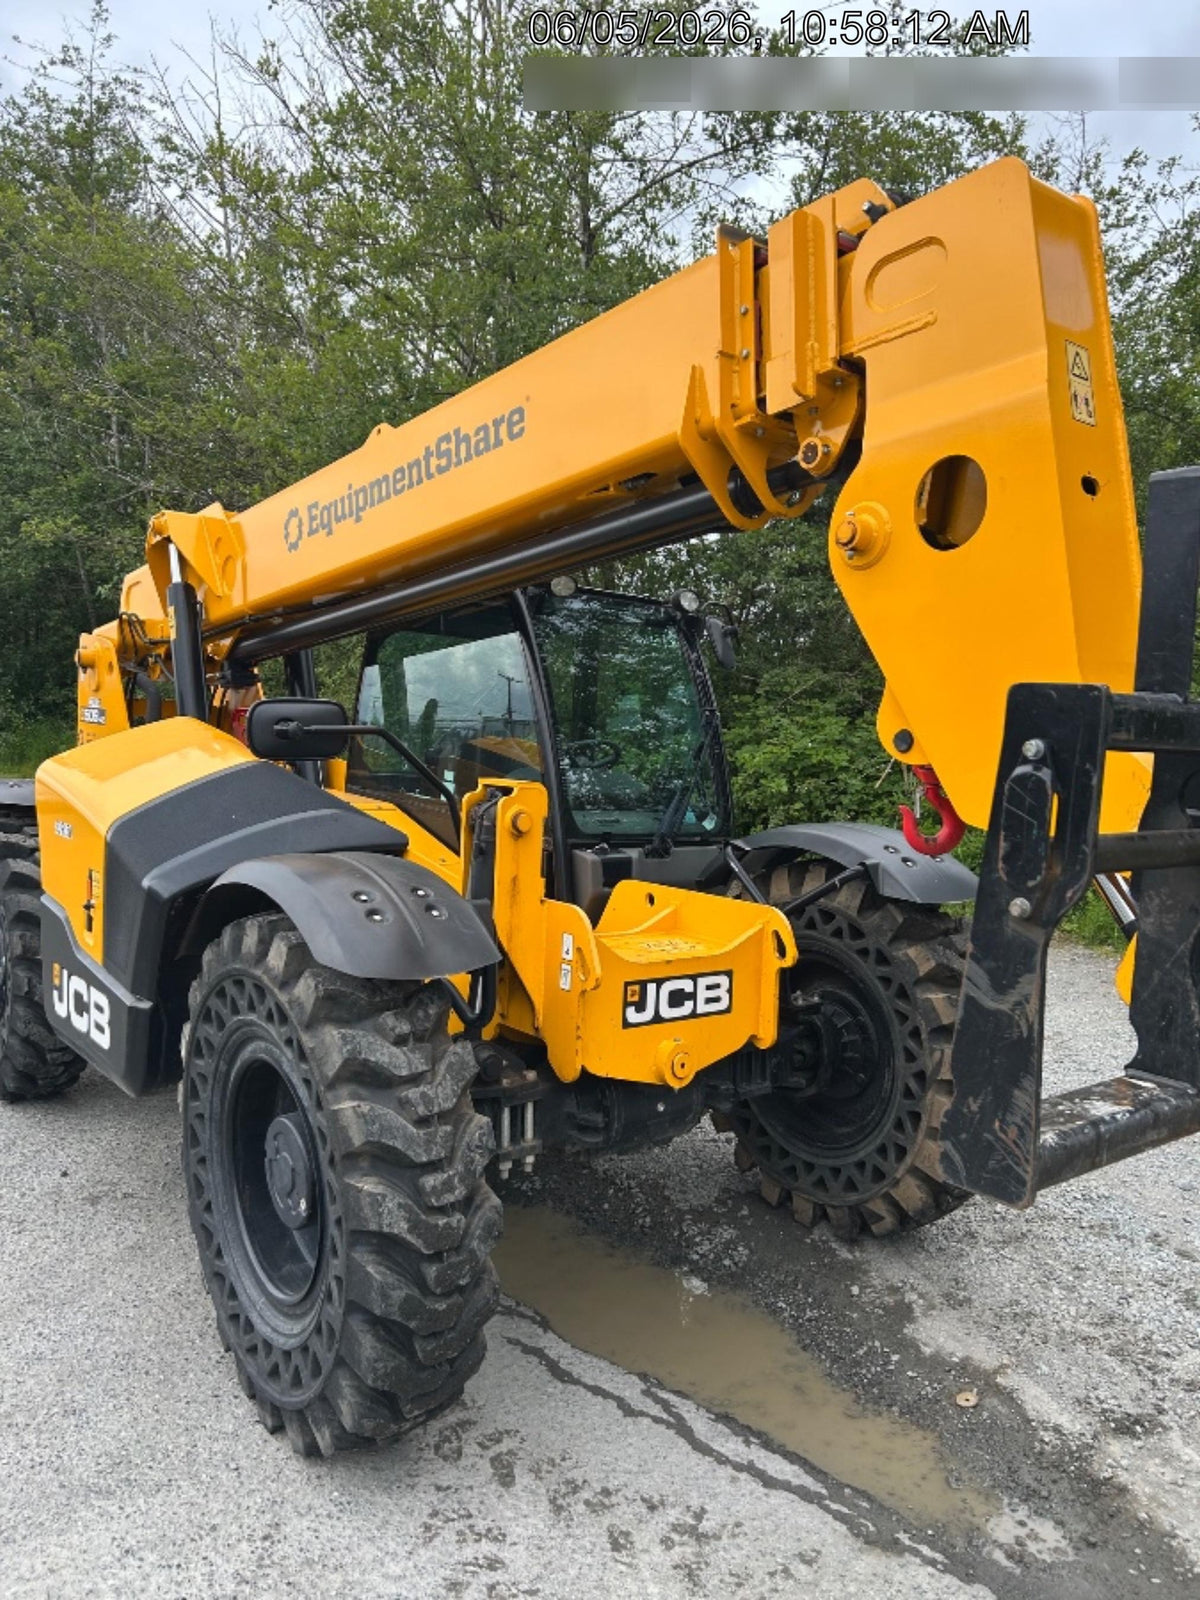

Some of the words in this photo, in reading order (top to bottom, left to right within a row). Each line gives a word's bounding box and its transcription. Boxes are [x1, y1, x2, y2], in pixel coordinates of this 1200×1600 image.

[306, 405, 526, 538] EquipmentShare
[53, 967, 111, 1050] JCB
[625, 974, 730, 1024] JCB
